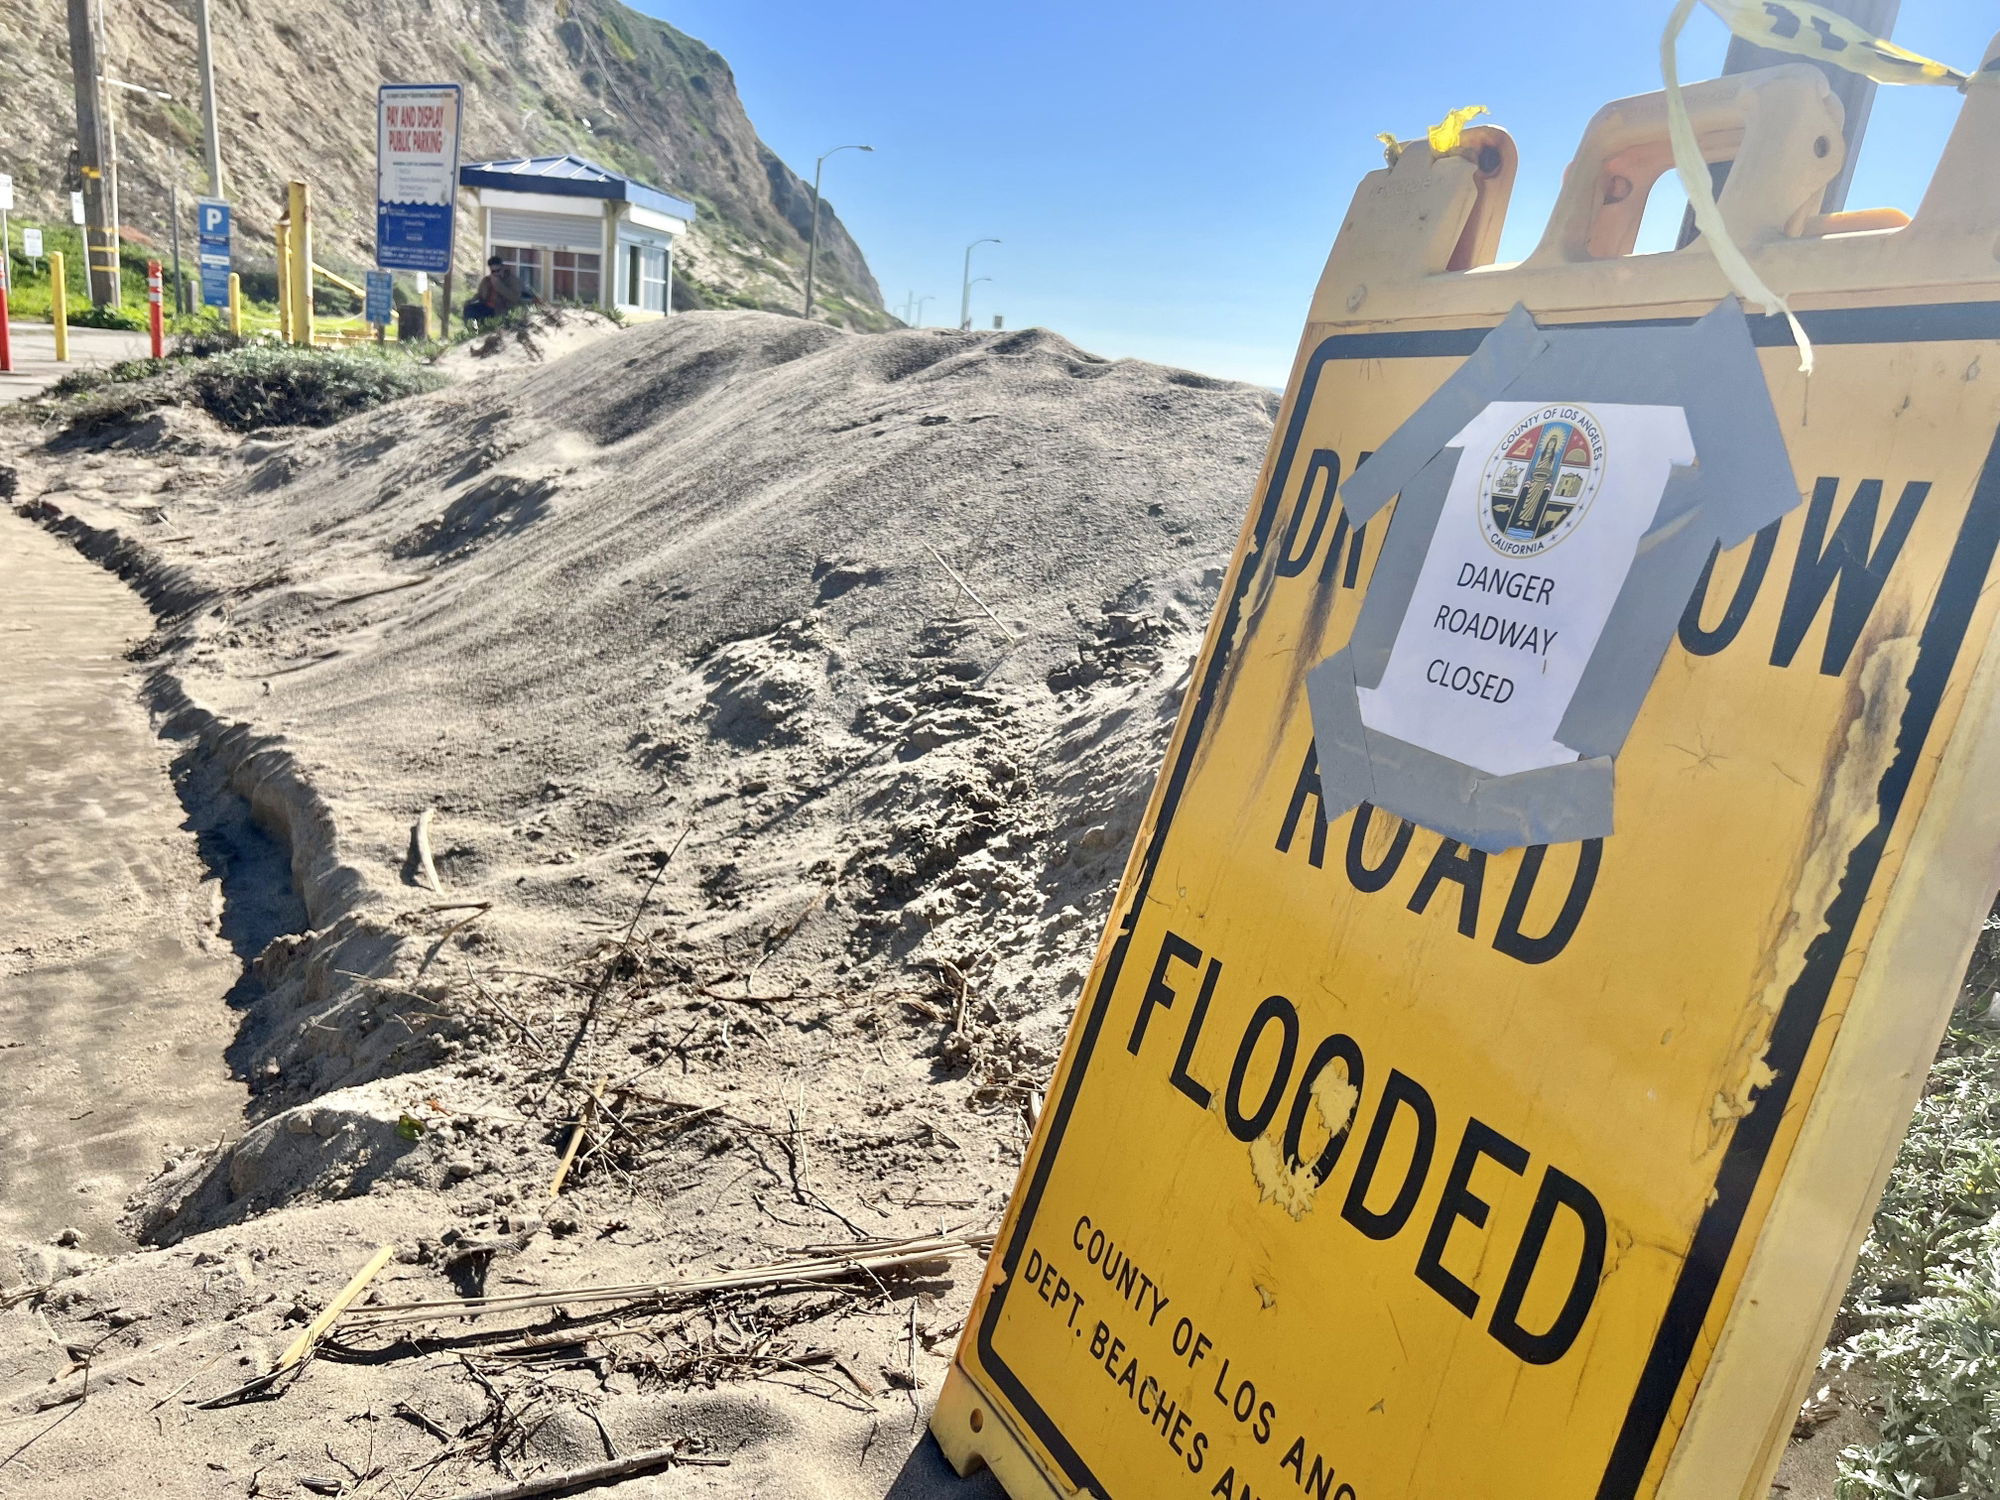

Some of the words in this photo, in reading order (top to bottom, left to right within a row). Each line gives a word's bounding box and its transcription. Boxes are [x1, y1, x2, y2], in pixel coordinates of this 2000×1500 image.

[387, 105, 399, 127] PAY
[400, 105, 416, 128] AND
[417, 105, 444, 128] DISPLAY
[389, 130, 411, 152] PUBLIC
[413, 130, 442, 153] PARKING
[206, 208, 223, 231] P
[1501, 414, 1540, 452] COUNTY
[1543, 408, 1558, 420] OF
[1560, 407, 1579, 421] LOS
[1577, 416, 1603, 461] ANGELES
[1490, 533, 1545, 555] CALIFORNIA
[1456, 562, 1555, 605] DANGER
[1677, 476, 1933, 678] OW
[1433, 604, 1559, 656] ROADWAY
[1426, 658, 1514, 704] CLOSED
[1126, 929, 1607, 1366] FLOODED
[1073, 1215, 1170, 1327] COUNTY
[1172, 1316, 1213, 1369] OF
[1213, 1358, 1276, 1445] LOS
[1024, 1247, 1085, 1338] DEPT.
[1089, 1319, 1209, 1474] BEACHES
